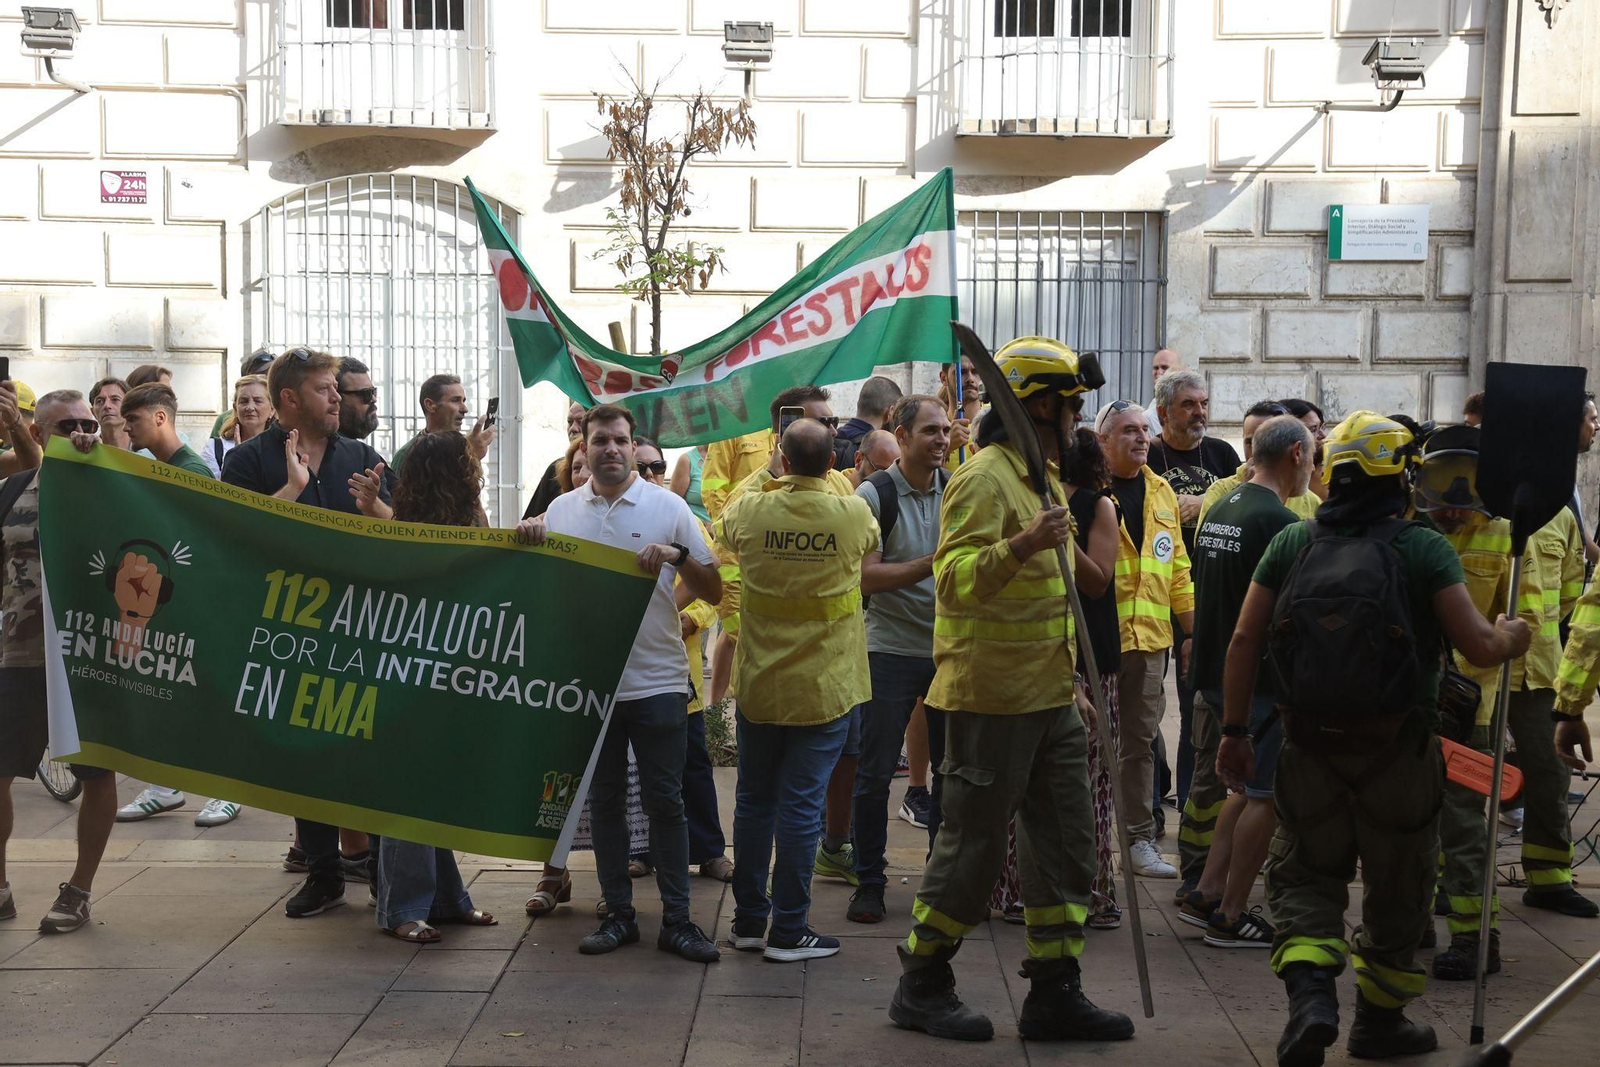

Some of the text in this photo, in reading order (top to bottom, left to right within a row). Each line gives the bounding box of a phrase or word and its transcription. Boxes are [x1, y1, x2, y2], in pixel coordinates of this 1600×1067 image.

[124, 180, 146, 190] 24h
[150, 463, 171, 478] 112
[173, 471, 247, 502] ATENDEMOS
[249, 495, 273, 509] TUS
[276, 503, 363, 531] EMERGENCIAS
[366, 522, 415, 537] ¿QUIEN
[418, 529, 476, 541] ATIENDE
[480, 531, 503, 542] LAS
[764, 530, 837, 552] INFOCA
[65, 609, 195, 659] 112 ANDALUCÍA
[261, 569, 525, 667] 112 ANDALUCÍA
[57, 630, 197, 687] EN LUCHA
[70, 664, 174, 701] HÉROES INVISIBLES
[249, 626, 610, 721] POR LA INTEGRACIÓN
[234, 661, 378, 740] EN EMA
